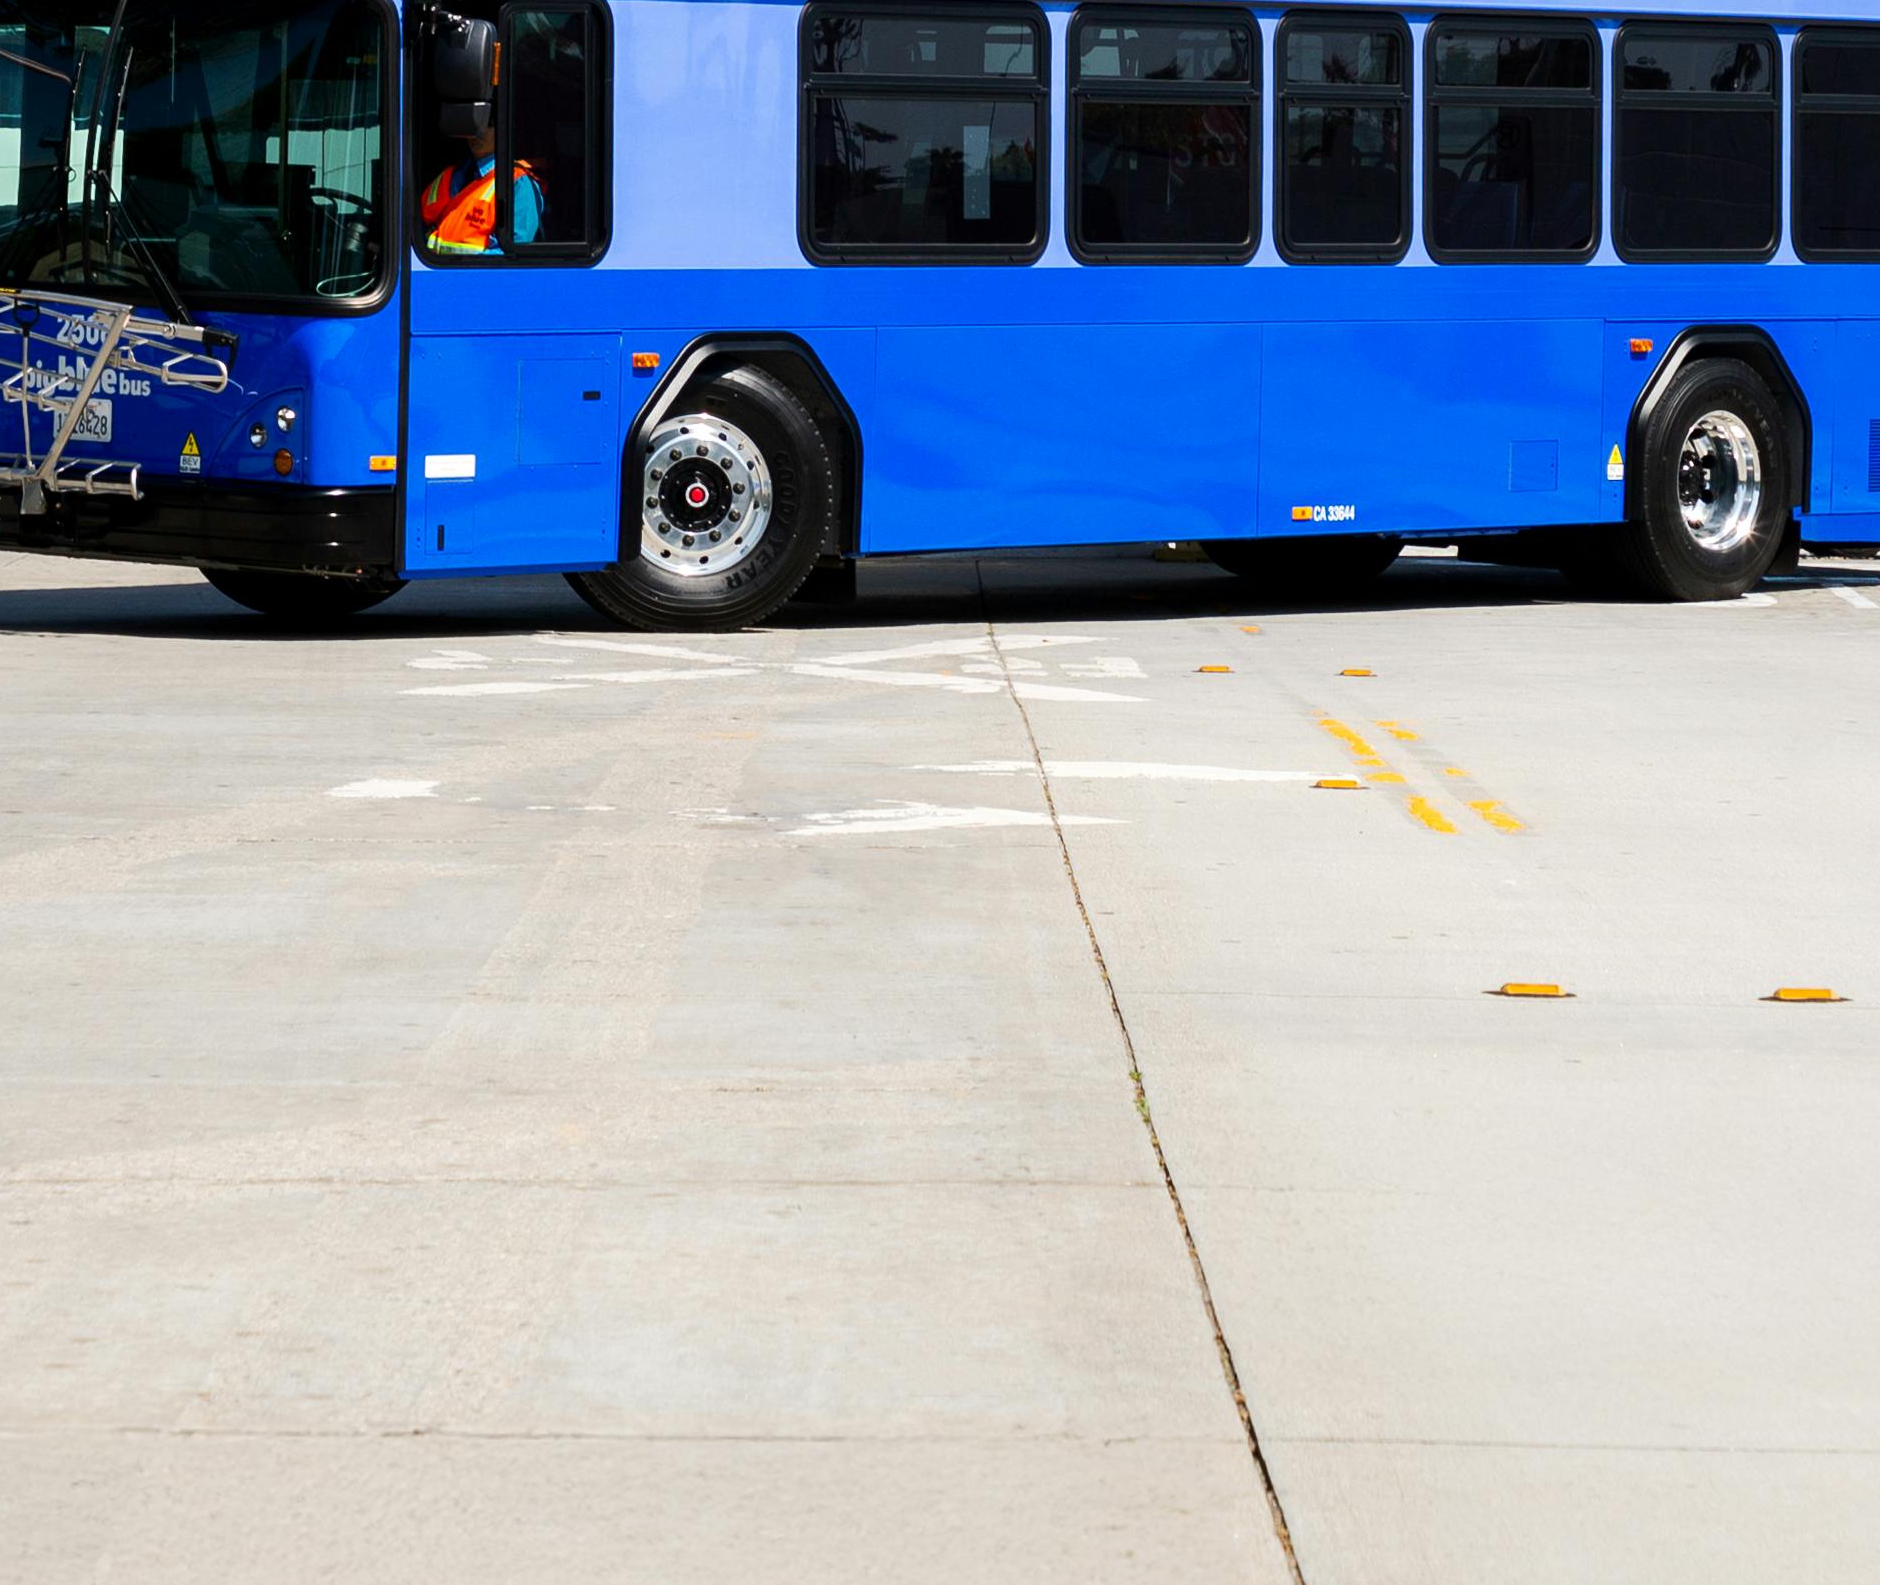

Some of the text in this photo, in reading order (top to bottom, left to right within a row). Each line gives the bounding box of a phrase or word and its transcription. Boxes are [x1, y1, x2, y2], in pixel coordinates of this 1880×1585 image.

[56, 314, 111, 346] 250
[119, 372, 151, 397] bus
[1313, 505, 1327, 521] CA
